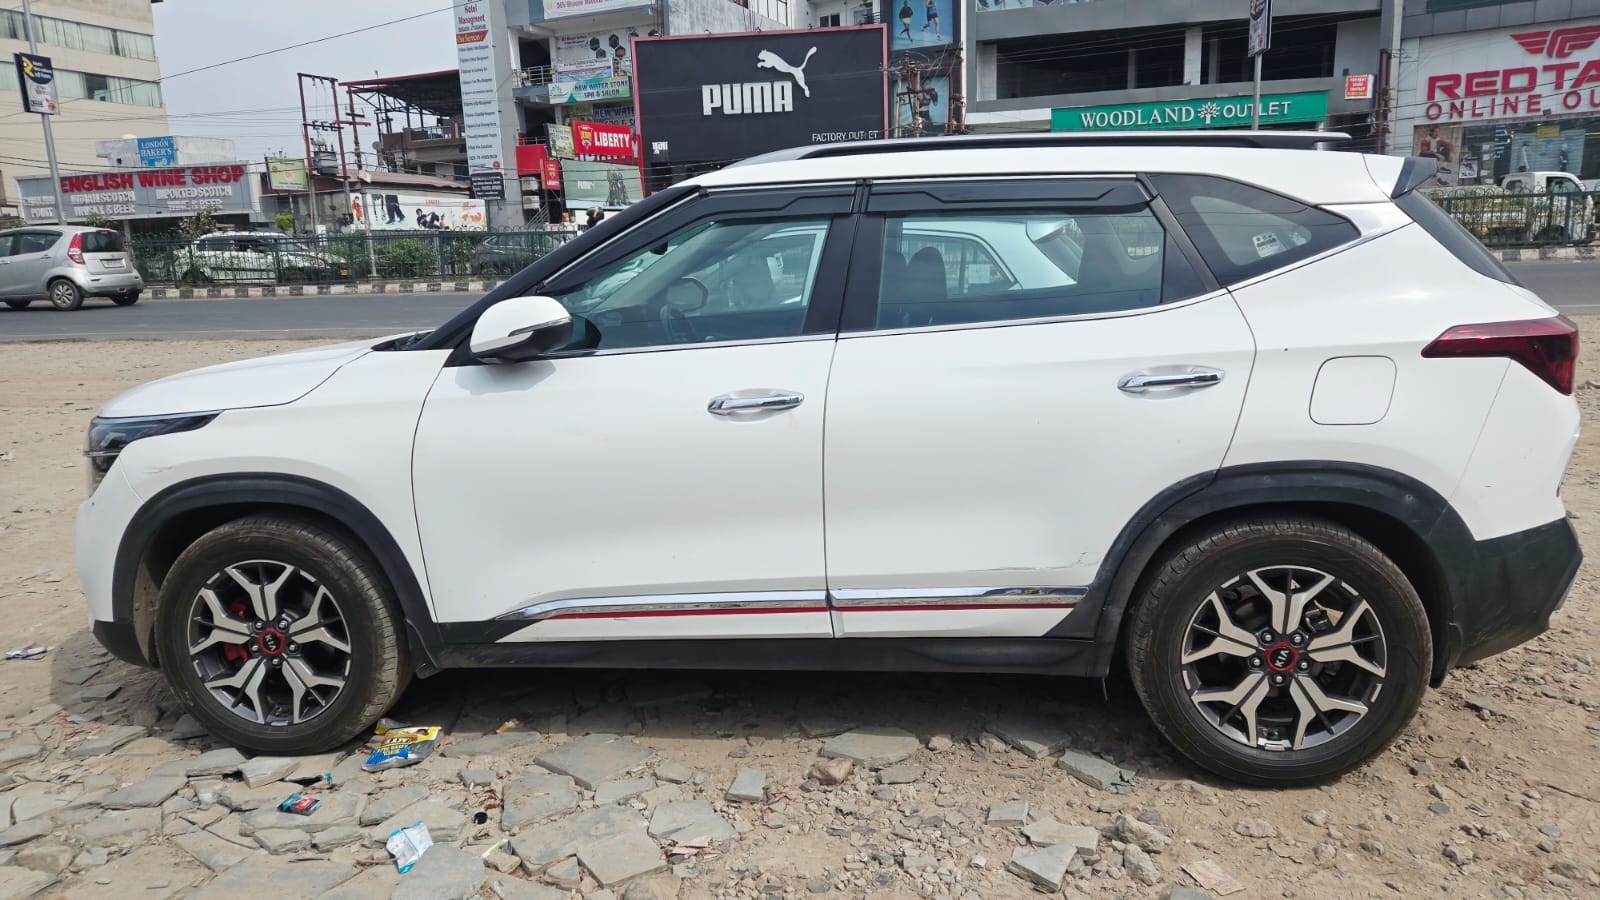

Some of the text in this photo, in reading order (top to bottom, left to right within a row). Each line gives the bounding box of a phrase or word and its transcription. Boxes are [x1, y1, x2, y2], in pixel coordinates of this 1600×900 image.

[574, 83, 588, 92] NEW
[589, 82, 608, 91] WATER
[583, 91, 595, 99] SPA
[601, 89, 620, 97] SALON
[701, 80, 794, 116] PUMA
[1079, 101, 1292, 128] WOODLAND OUTLET
[1425, 94, 1543, 121] ONLINE
[141, 140, 169, 149] LONDON
[593, 131, 631, 148] LIBERTY
[812, 132, 847, 142] FACTORY
[140, 148, 173, 158] BAKER'S
[60, 164, 245, 194] ENGLISH WINE SHOP
[102, 190, 136, 203] SCOTCH
[155, 185, 232, 200] IMPORTED SCOTCH
[1274, 650, 1289, 668] KIA
